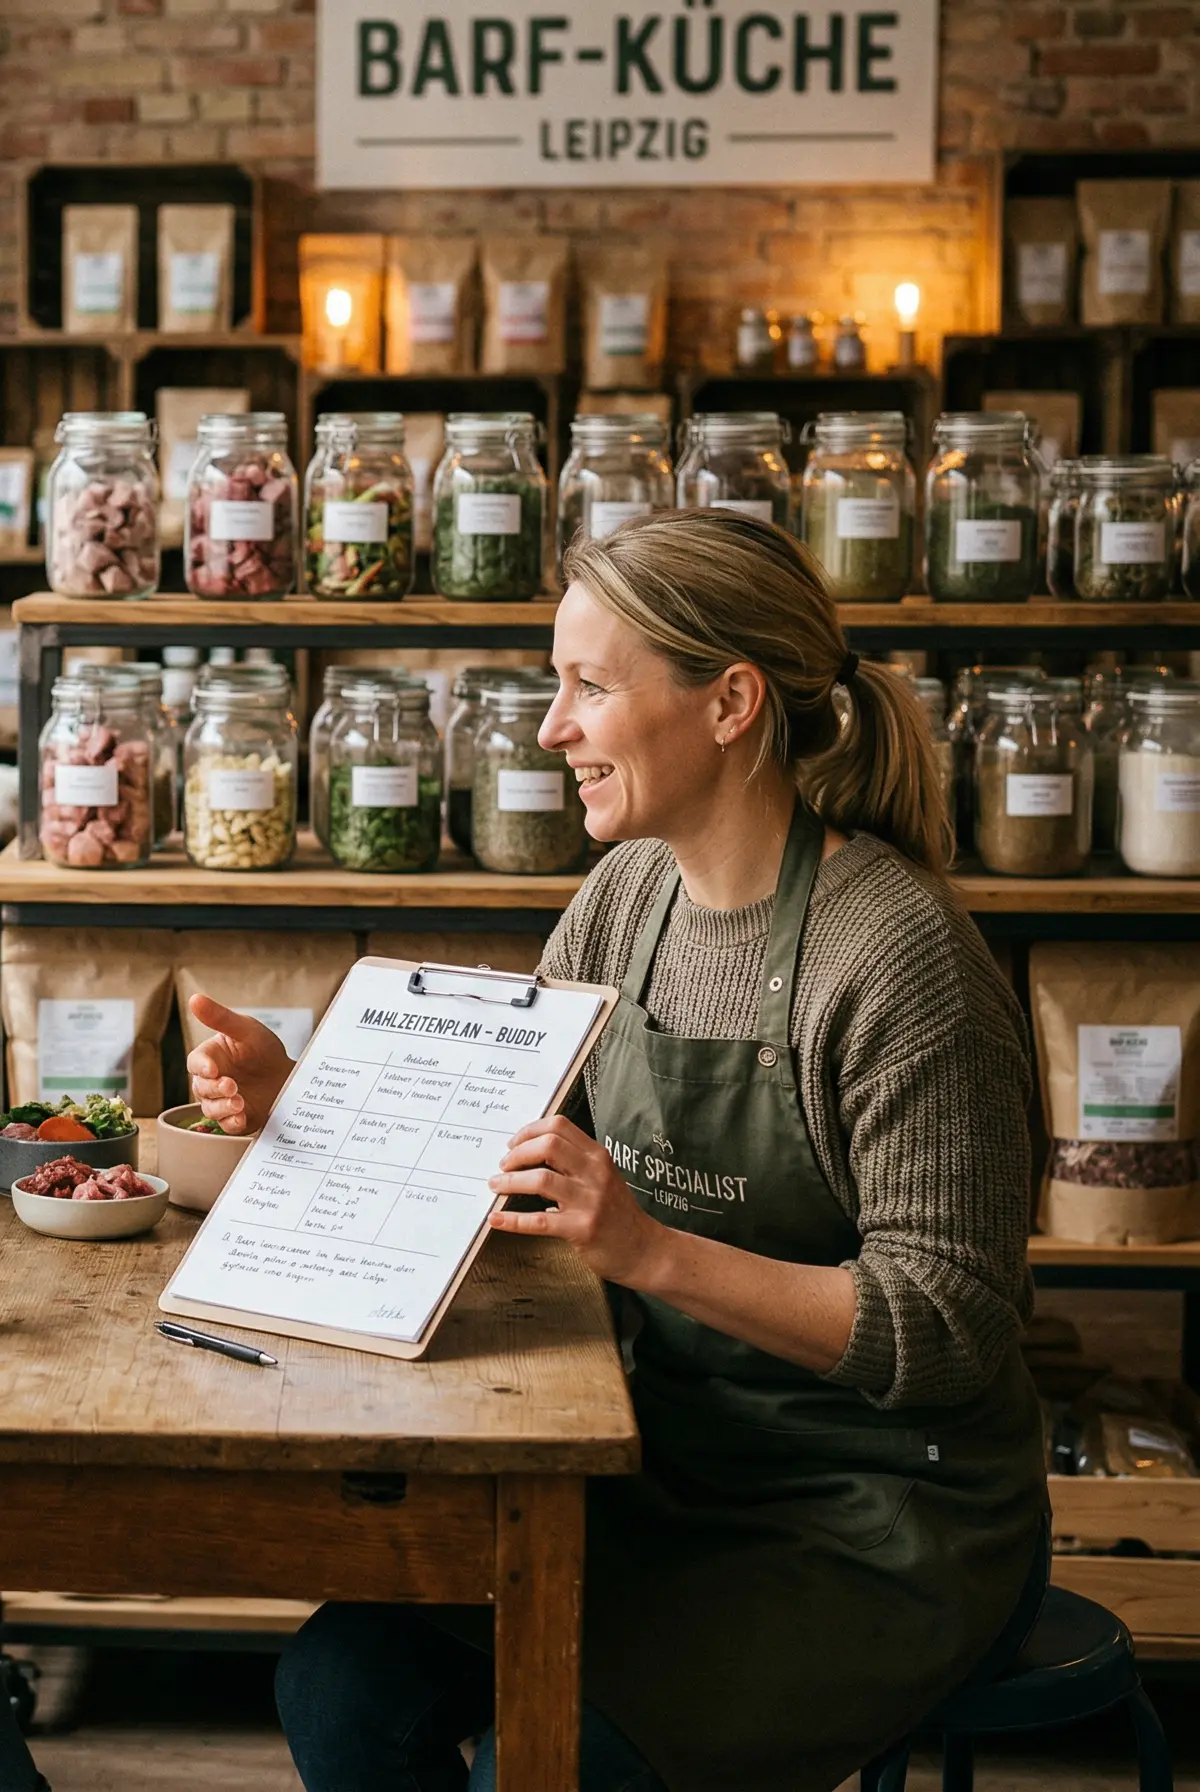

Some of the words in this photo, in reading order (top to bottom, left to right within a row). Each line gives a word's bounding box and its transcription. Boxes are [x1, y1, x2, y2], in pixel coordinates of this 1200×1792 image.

[356, 0, 898, 97] BARF-KÜCHE
[540, 118, 709, 162] LEIPZIG
[360, 1008, 483, 1039] MAHLZEITENPLAN
[496, 1026, 547, 1048] BUDDY
[644, 1155, 747, 1202] SPECIALIST
[654, 1188, 689, 1212] LEIPZIG
